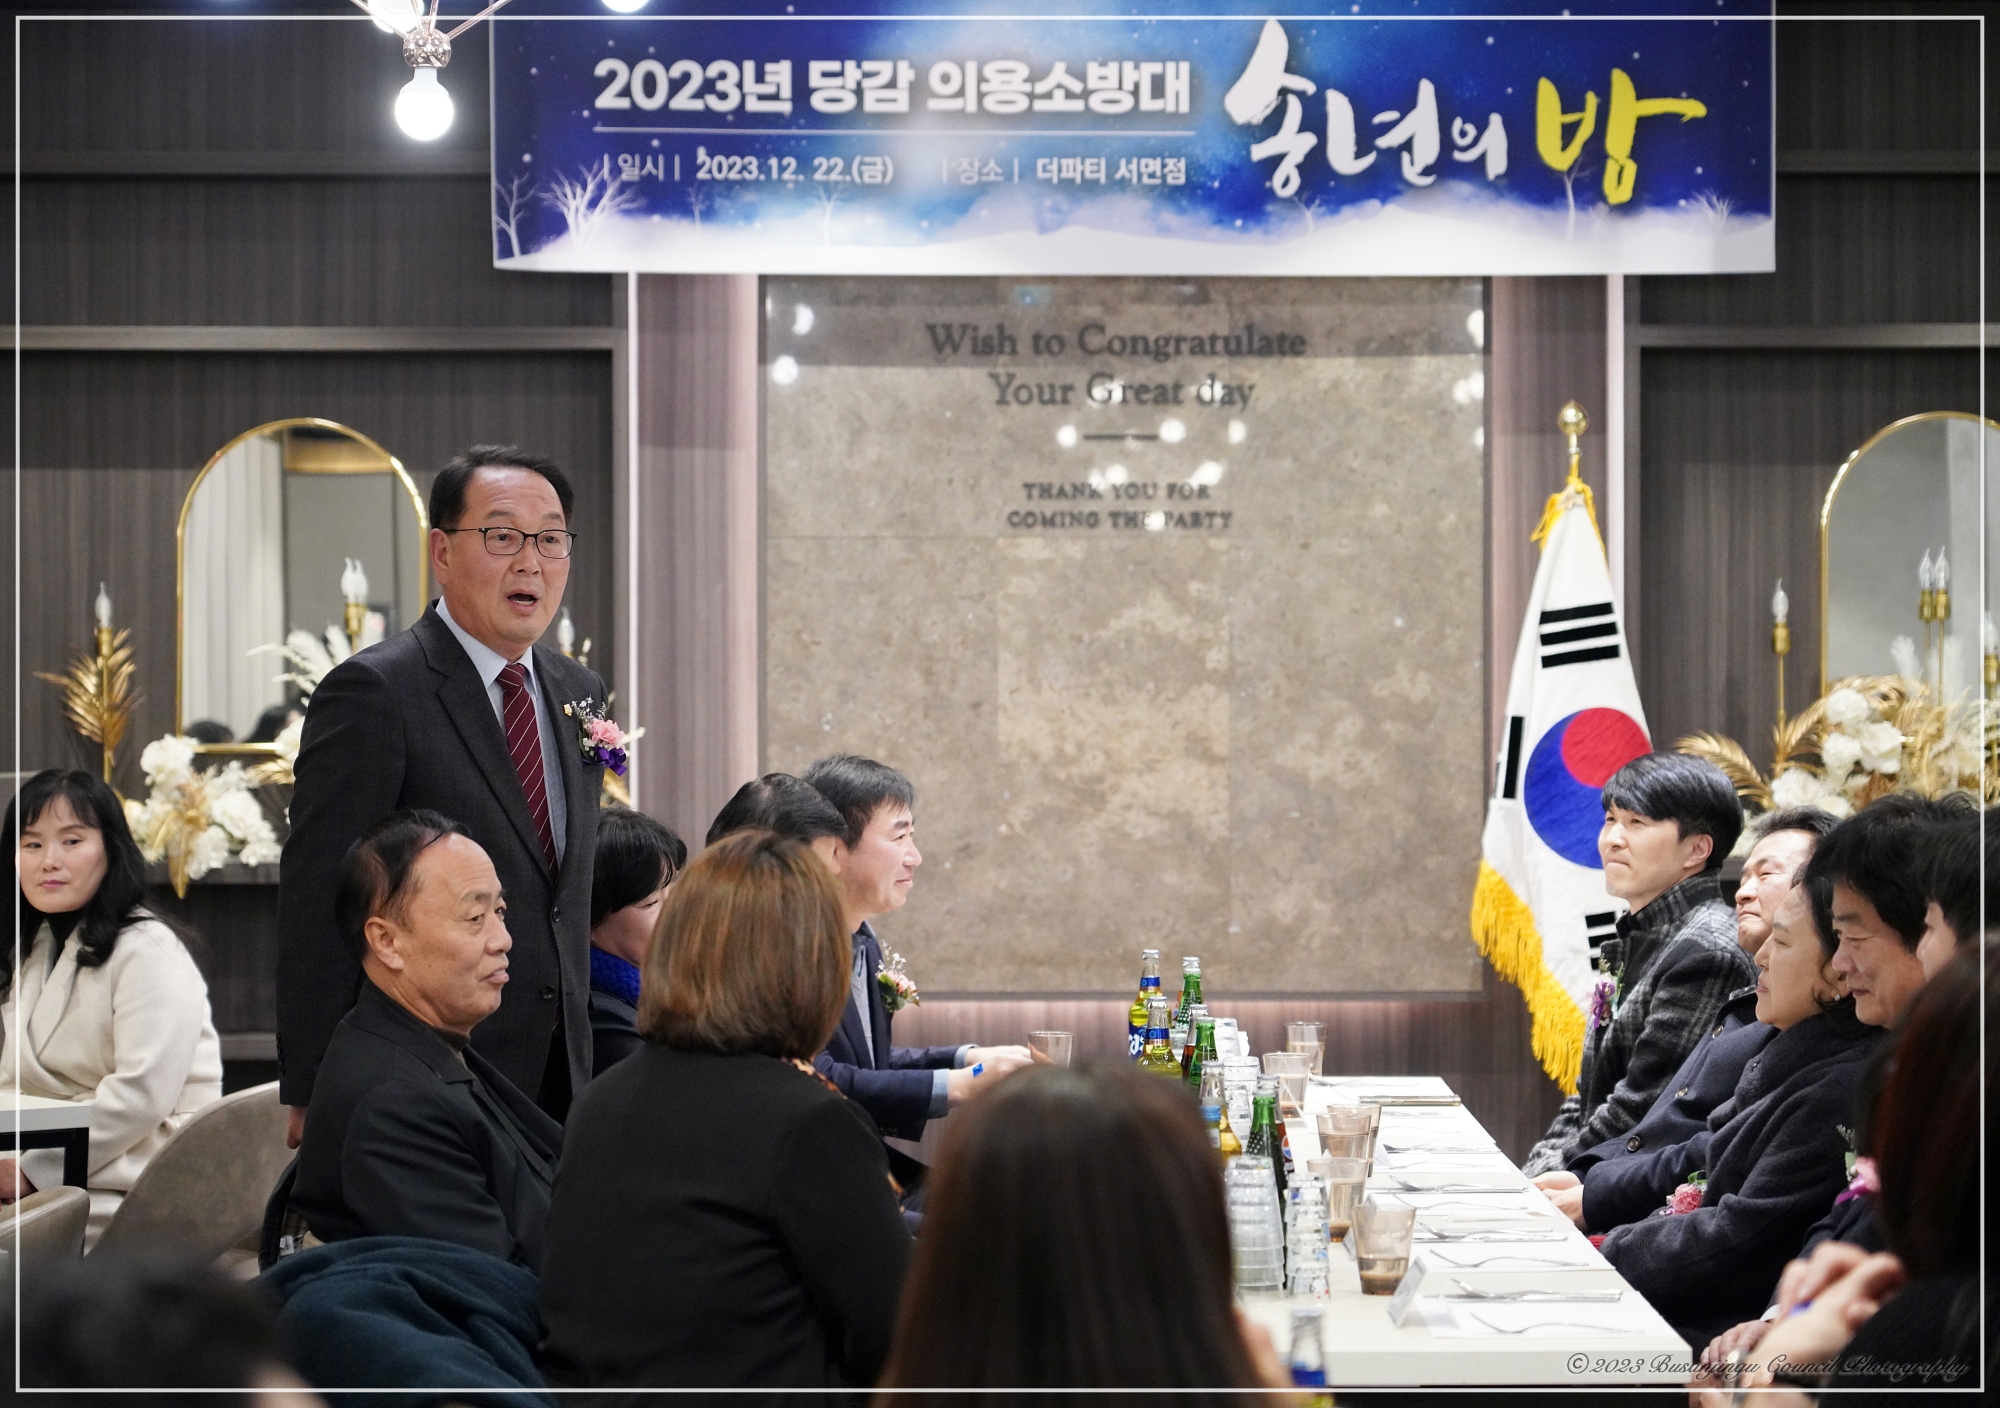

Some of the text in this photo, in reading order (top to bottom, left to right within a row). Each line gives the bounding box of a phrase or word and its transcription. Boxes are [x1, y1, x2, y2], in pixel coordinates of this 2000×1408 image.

[594, 57, 1190, 115] 2023년 당감 의용소방대
[1224, 18, 1707, 206] 송년의 밤
[617, 153, 665, 182] 일시
[695, 154, 805, 182] 2023.12.
[957, 156, 1187, 186] 장소 더파티 서면점
[925, 323, 1308, 362] Wish to Congratulate
[989, 371, 1256, 412] Your Great day
[1023, 482, 1211, 500] THANK YOU FOR
[1007, 510, 1100, 529] COMING
